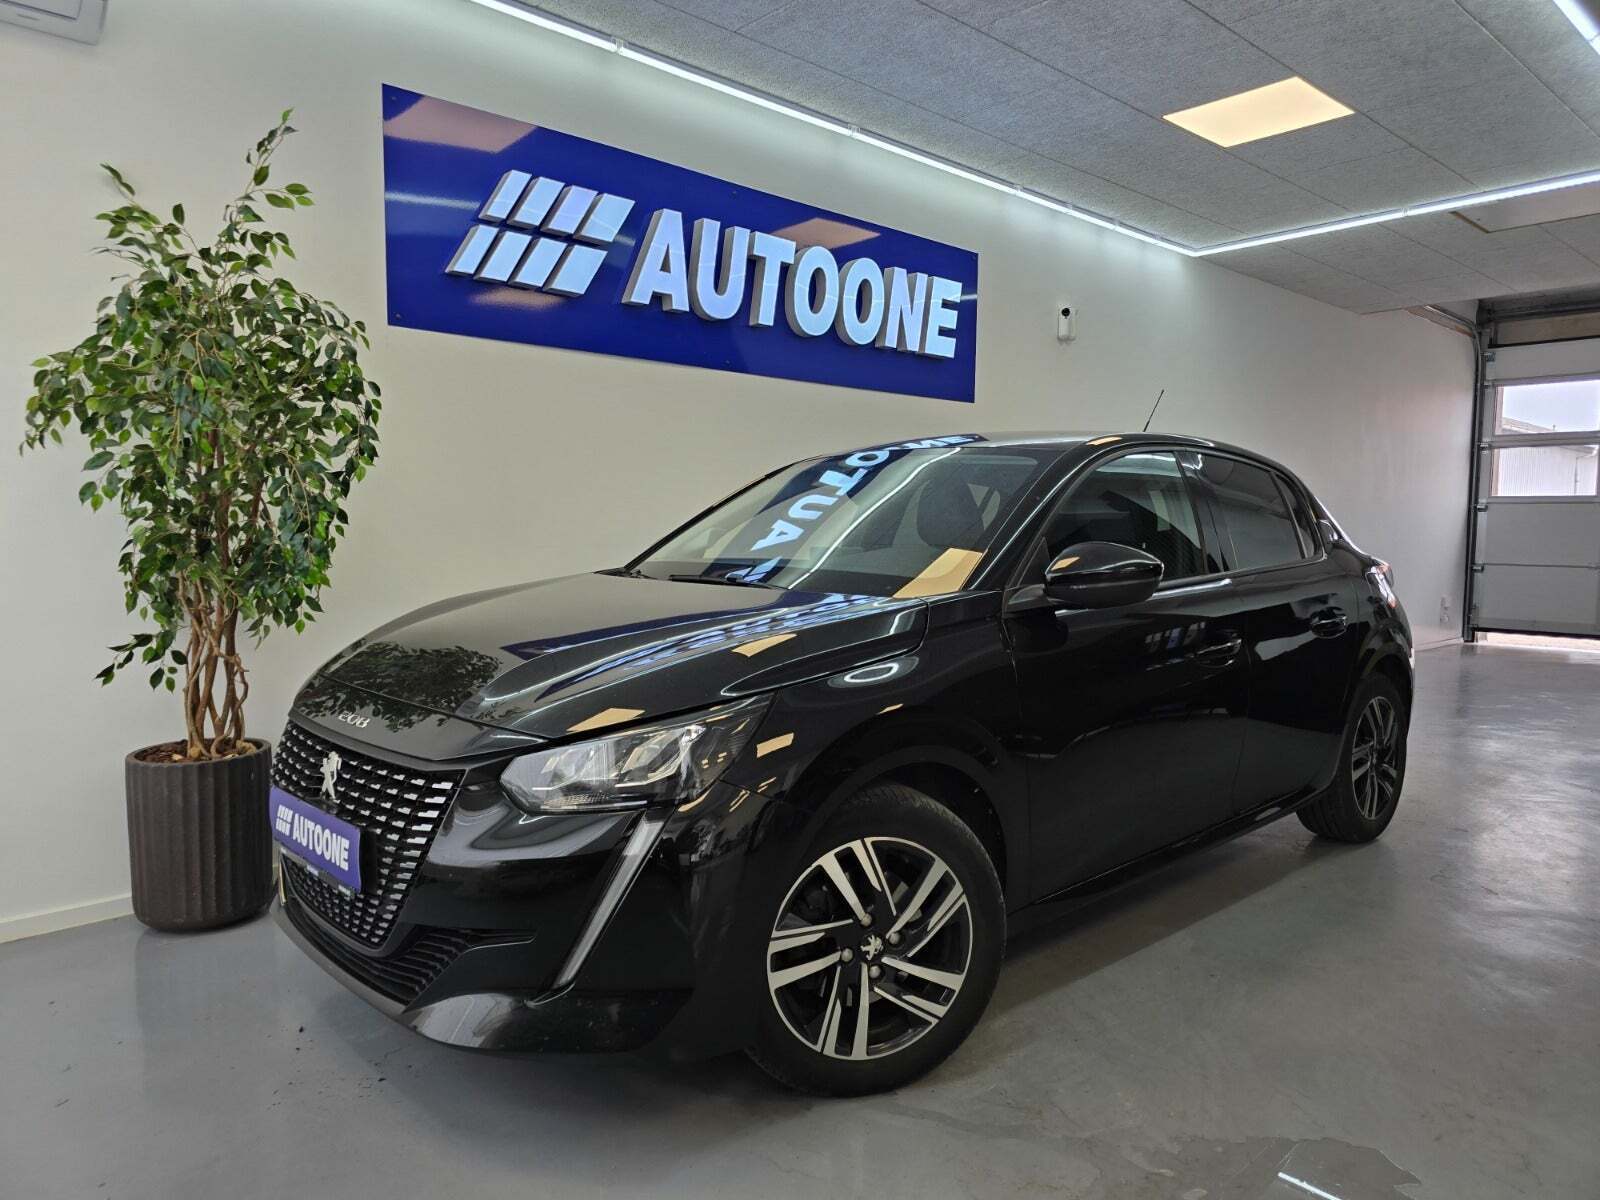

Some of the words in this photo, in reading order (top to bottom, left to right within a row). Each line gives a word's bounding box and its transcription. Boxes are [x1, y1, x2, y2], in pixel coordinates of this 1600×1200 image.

[621, 208, 962, 358] AUTOONE
[338, 710, 370, 728] 208
[293, 813, 349, 871] AUTOONE
